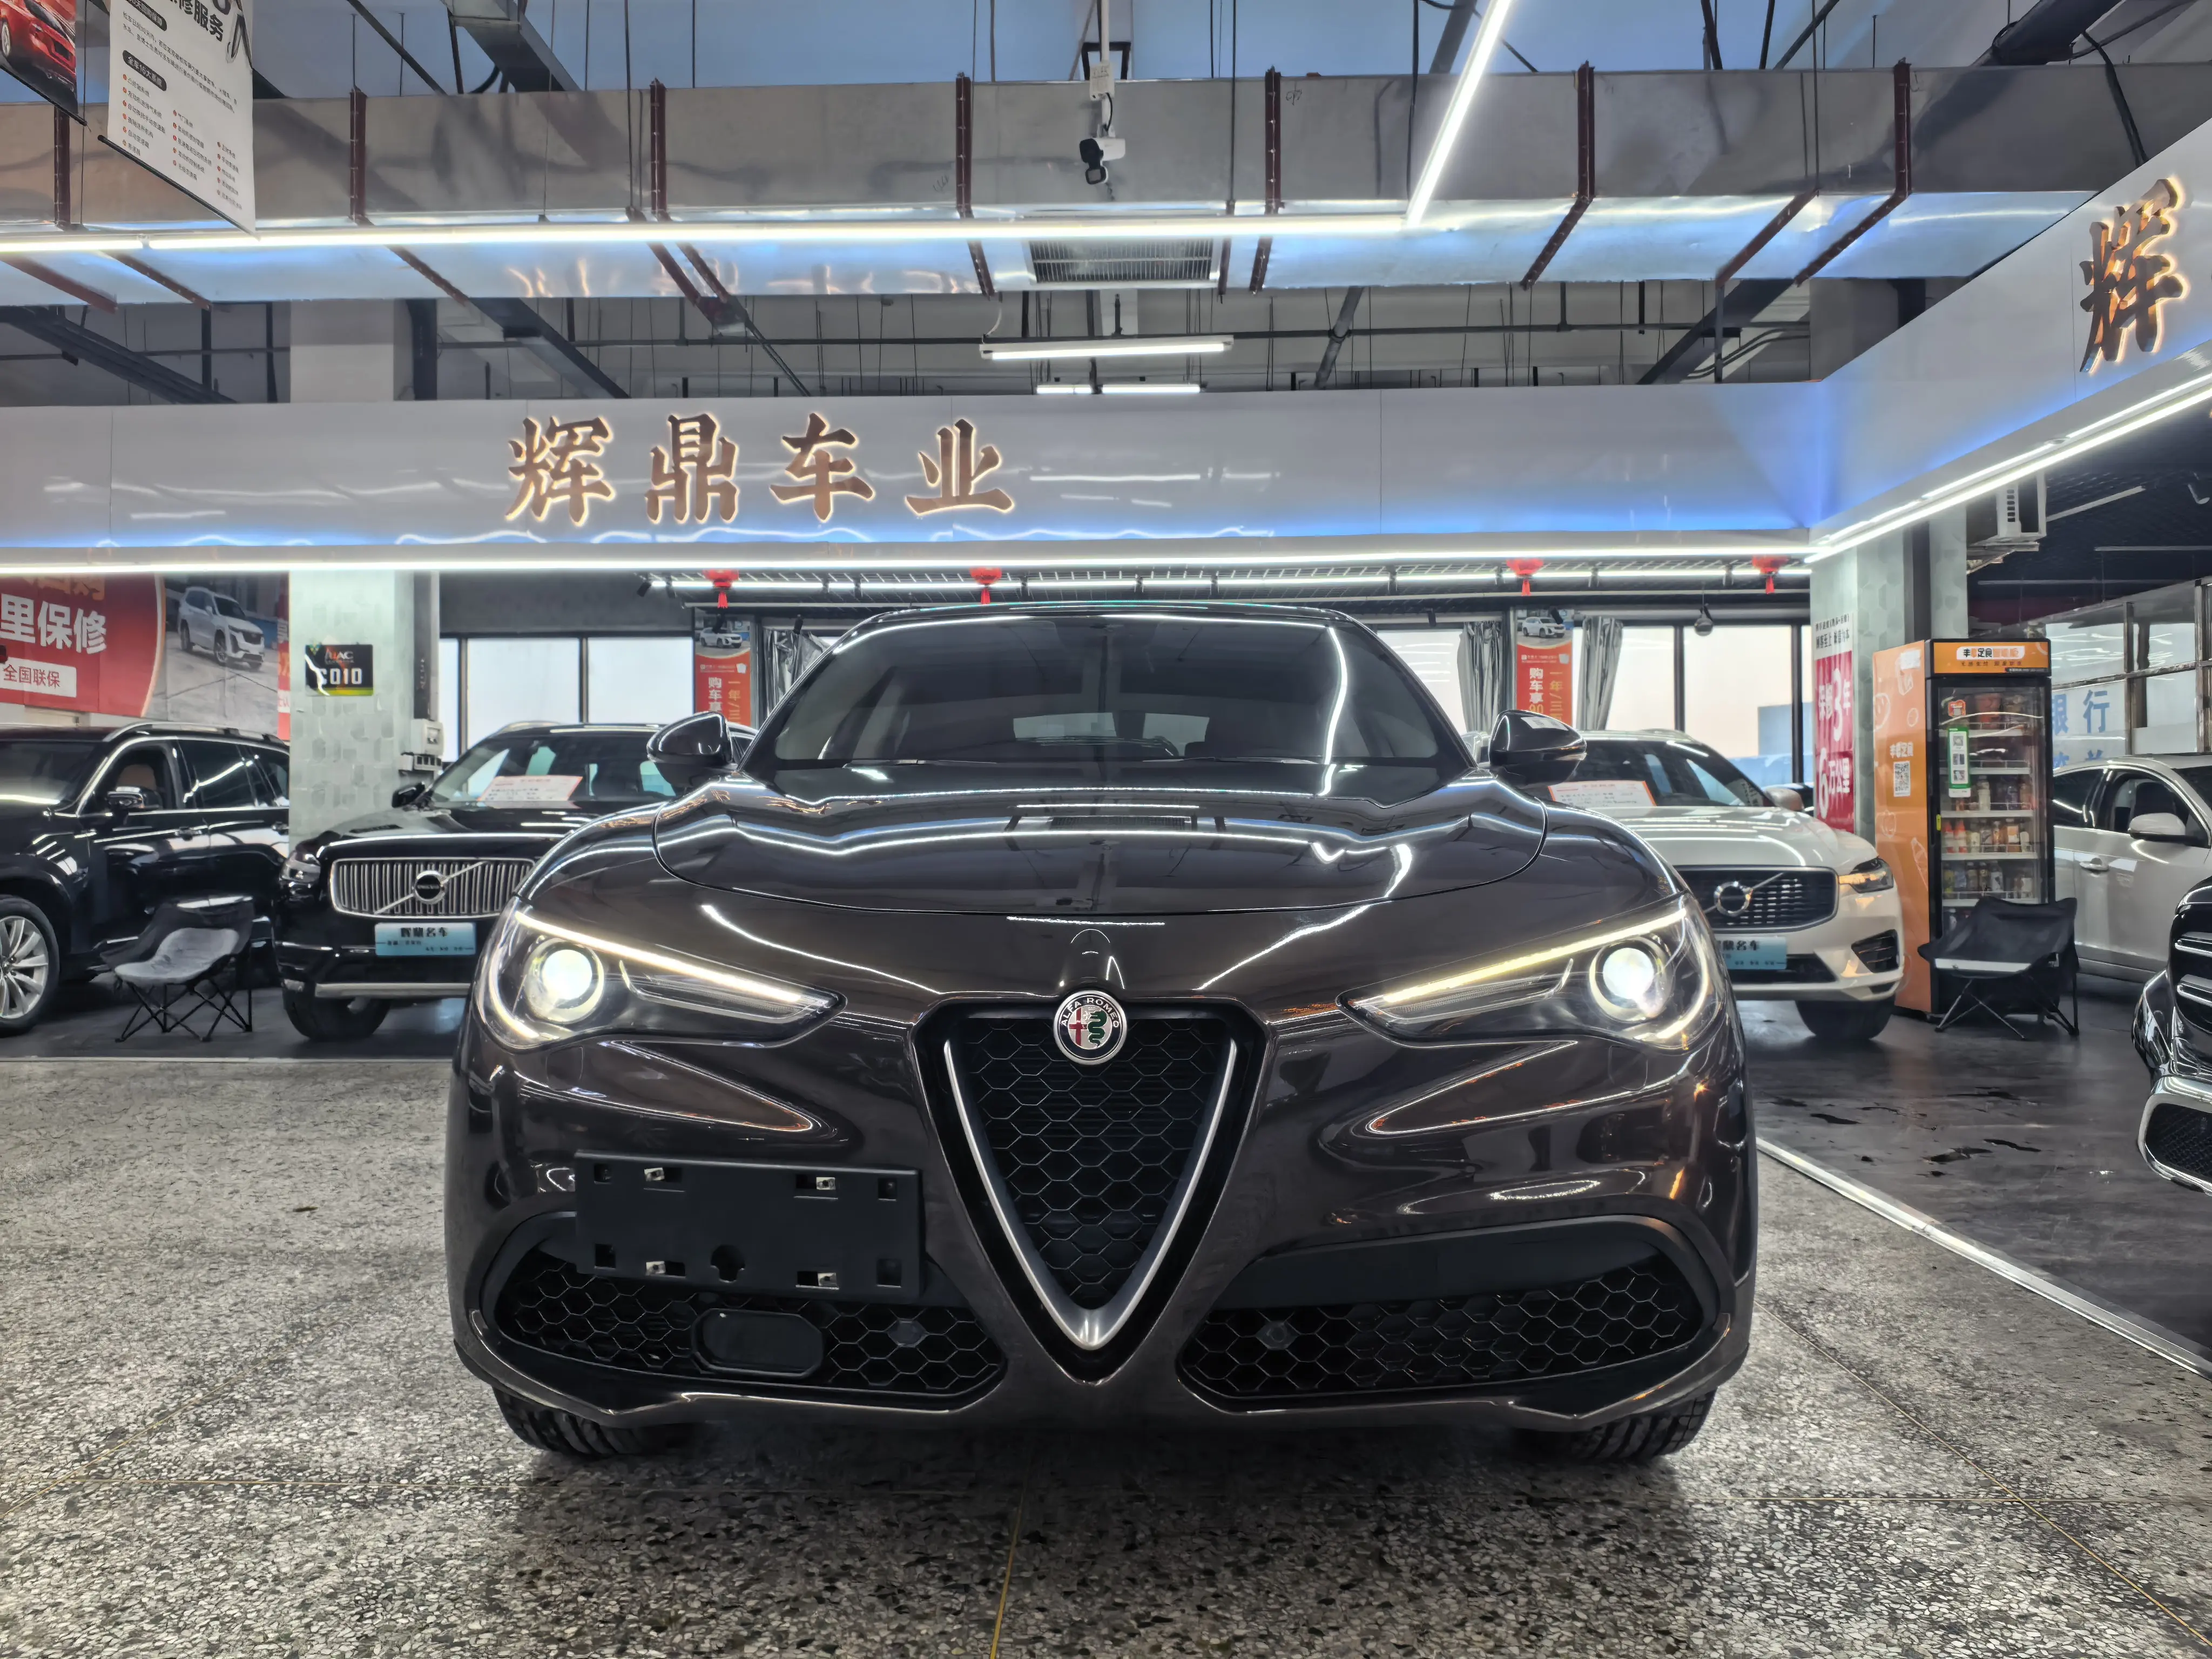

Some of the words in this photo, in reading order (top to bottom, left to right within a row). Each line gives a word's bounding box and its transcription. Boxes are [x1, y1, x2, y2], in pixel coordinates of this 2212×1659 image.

[168, 0, 224, 42] 修服务
[2079, 177, 2187, 375] 辉
[505, 411, 1016, 527] 辉鼎车业
[0, 593, 107, 655] 里保修
[3, 664, 60, 689] 全国联保
[1818, 747, 1850, 820] 6万公里
[1061, 1001, 1082, 1027] ALFA
[1086, 997, 1120, 1028] ROMEO
